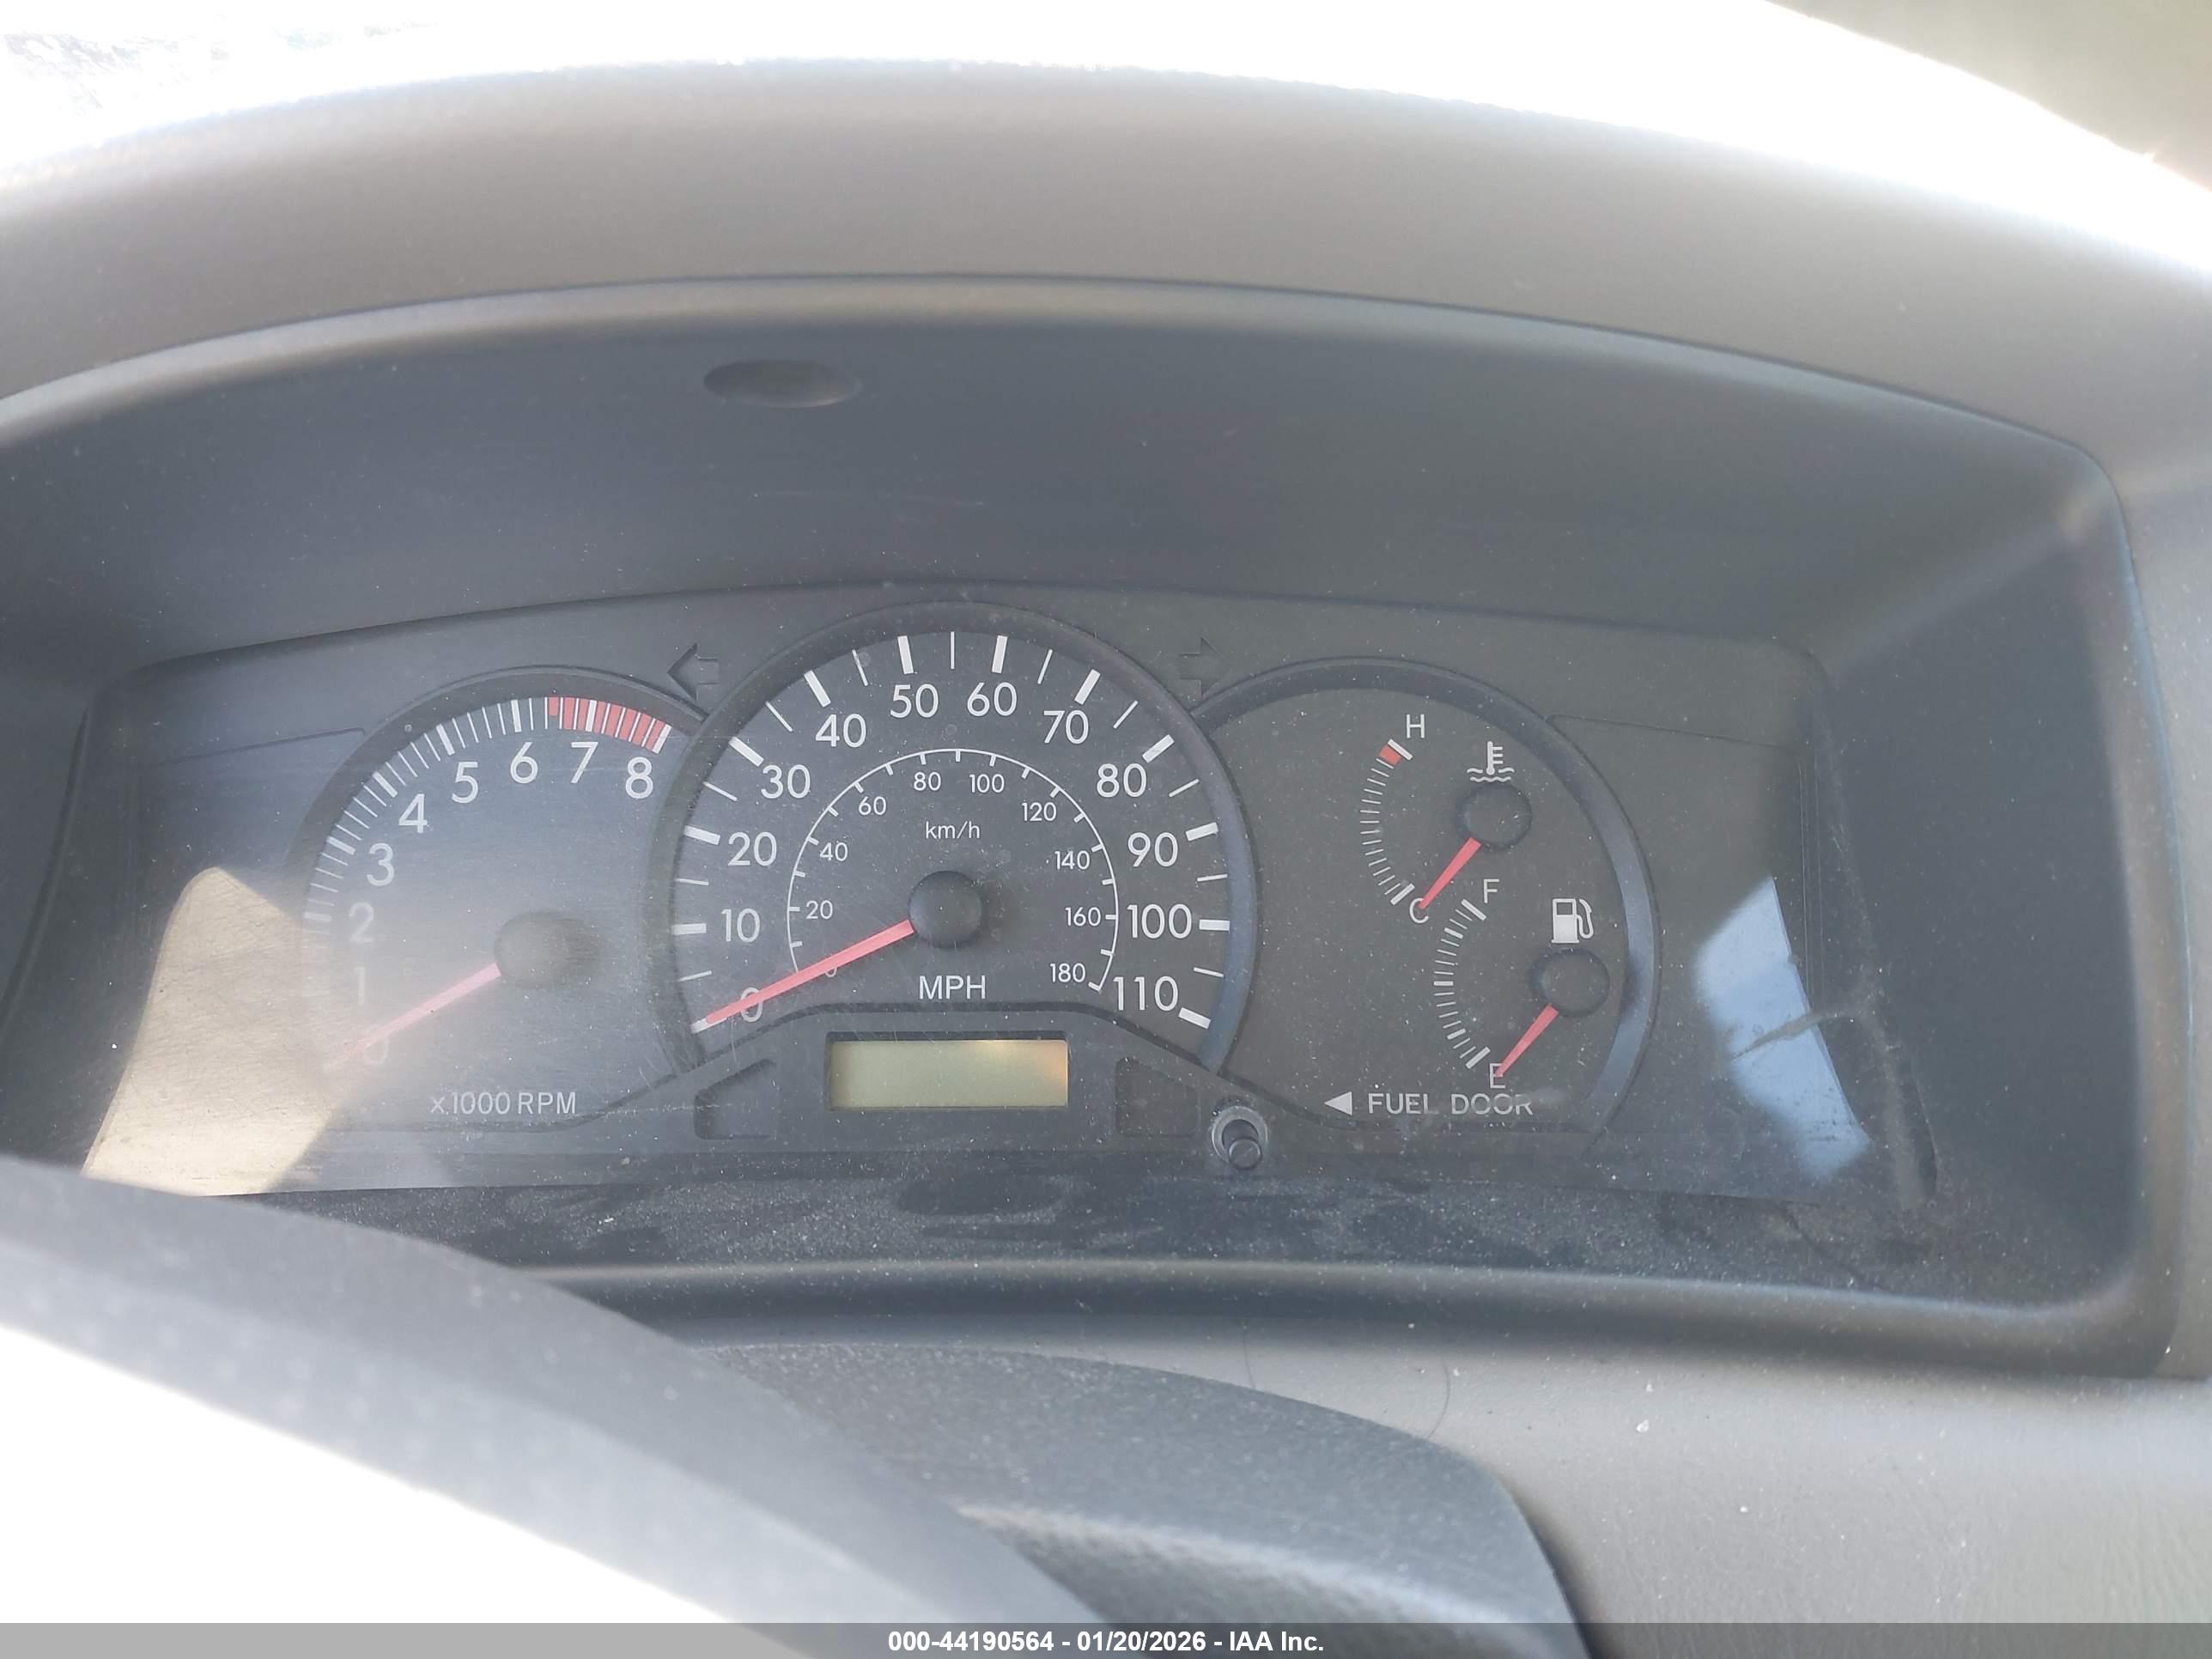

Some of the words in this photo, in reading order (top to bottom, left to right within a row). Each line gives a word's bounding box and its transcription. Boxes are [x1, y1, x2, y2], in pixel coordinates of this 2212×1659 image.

[890, 684, 939, 718] 50
[966, 683, 1017, 716] 60
[816, 714, 866, 747] 40
[1043, 710, 1089, 744] 70
[1407, 714, 1425, 738] H
[510, 741, 538, 783] 6
[571, 742, 599, 783] 7
[625, 757, 653, 799] 8
[452, 761, 478, 803] 5
[761, 764, 811, 799] 30
[914, 772, 941, 792] 80
[969, 774, 1005, 793] 100
[1097, 763, 1146, 798] 80
[398, 793, 427, 832] 4
[859, 797, 887, 816] 60
[1022, 801, 1057, 823] 120
[925, 821, 981, 841] km/h
[367, 843, 394, 885] 3
[727, 832, 777, 866] 20
[819, 842, 848, 862] 40
[1054, 851, 1091, 871] 140
[1127, 832, 1178, 867] 90
[1483, 878, 1499, 903] F
[349, 902, 374, 943] 2
[721, 908, 760, 942] 10
[805, 901, 834, 920] 20
[1065, 907, 1101, 927] 160
[1127, 903, 1192, 939] 100
[1409, 897, 1429, 923] C
[355, 966, 365, 1006] 1
[919, 976, 986, 1000] MPH
[1050, 963, 1086, 983] 180
[1113, 976, 1178, 1012] 110
[1490, 1063, 1505, 1089] E
[518, 1092, 576, 1114] RPM
[1368, 1093, 1432, 1115] FUEL
[1451, 1093, 1533, 1115] DOOR
